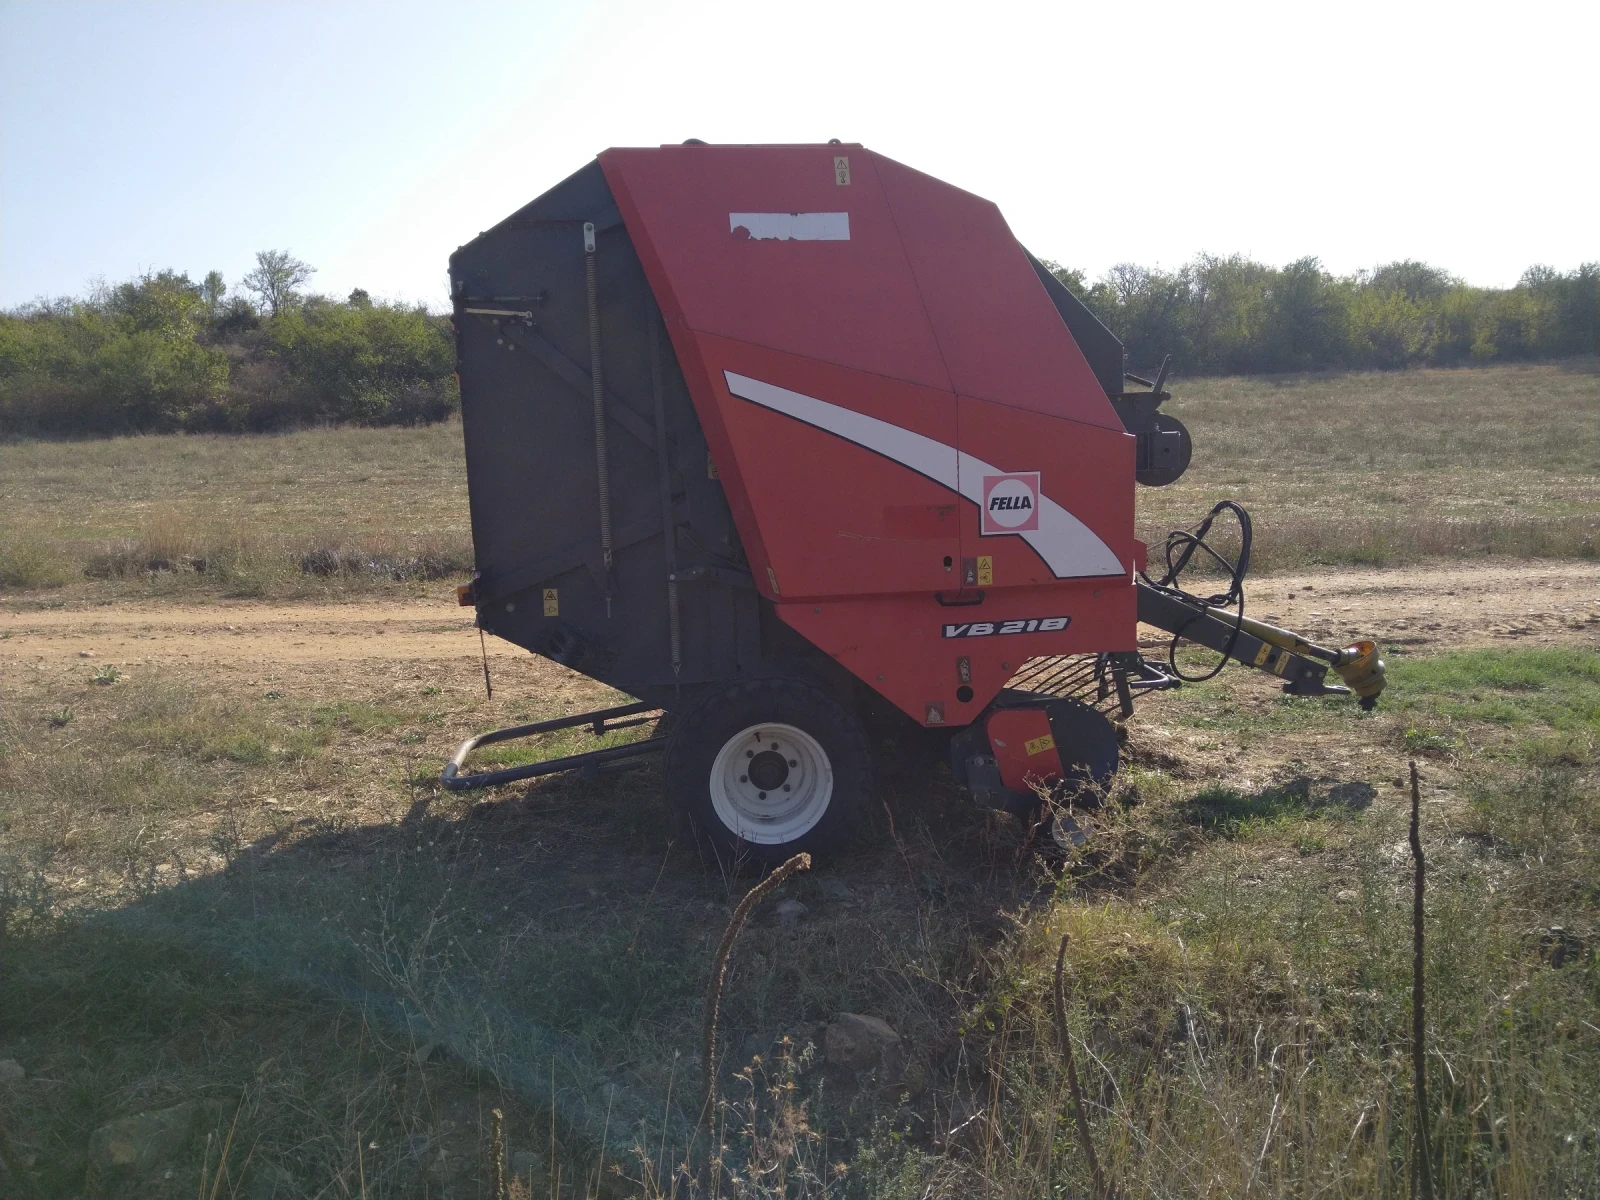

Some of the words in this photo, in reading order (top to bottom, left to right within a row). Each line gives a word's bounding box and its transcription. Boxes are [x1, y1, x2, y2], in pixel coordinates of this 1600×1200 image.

[989, 496, 1032, 511] FELLA
[945, 622, 994, 638] VB
[998, 617, 1068, 635] 218
